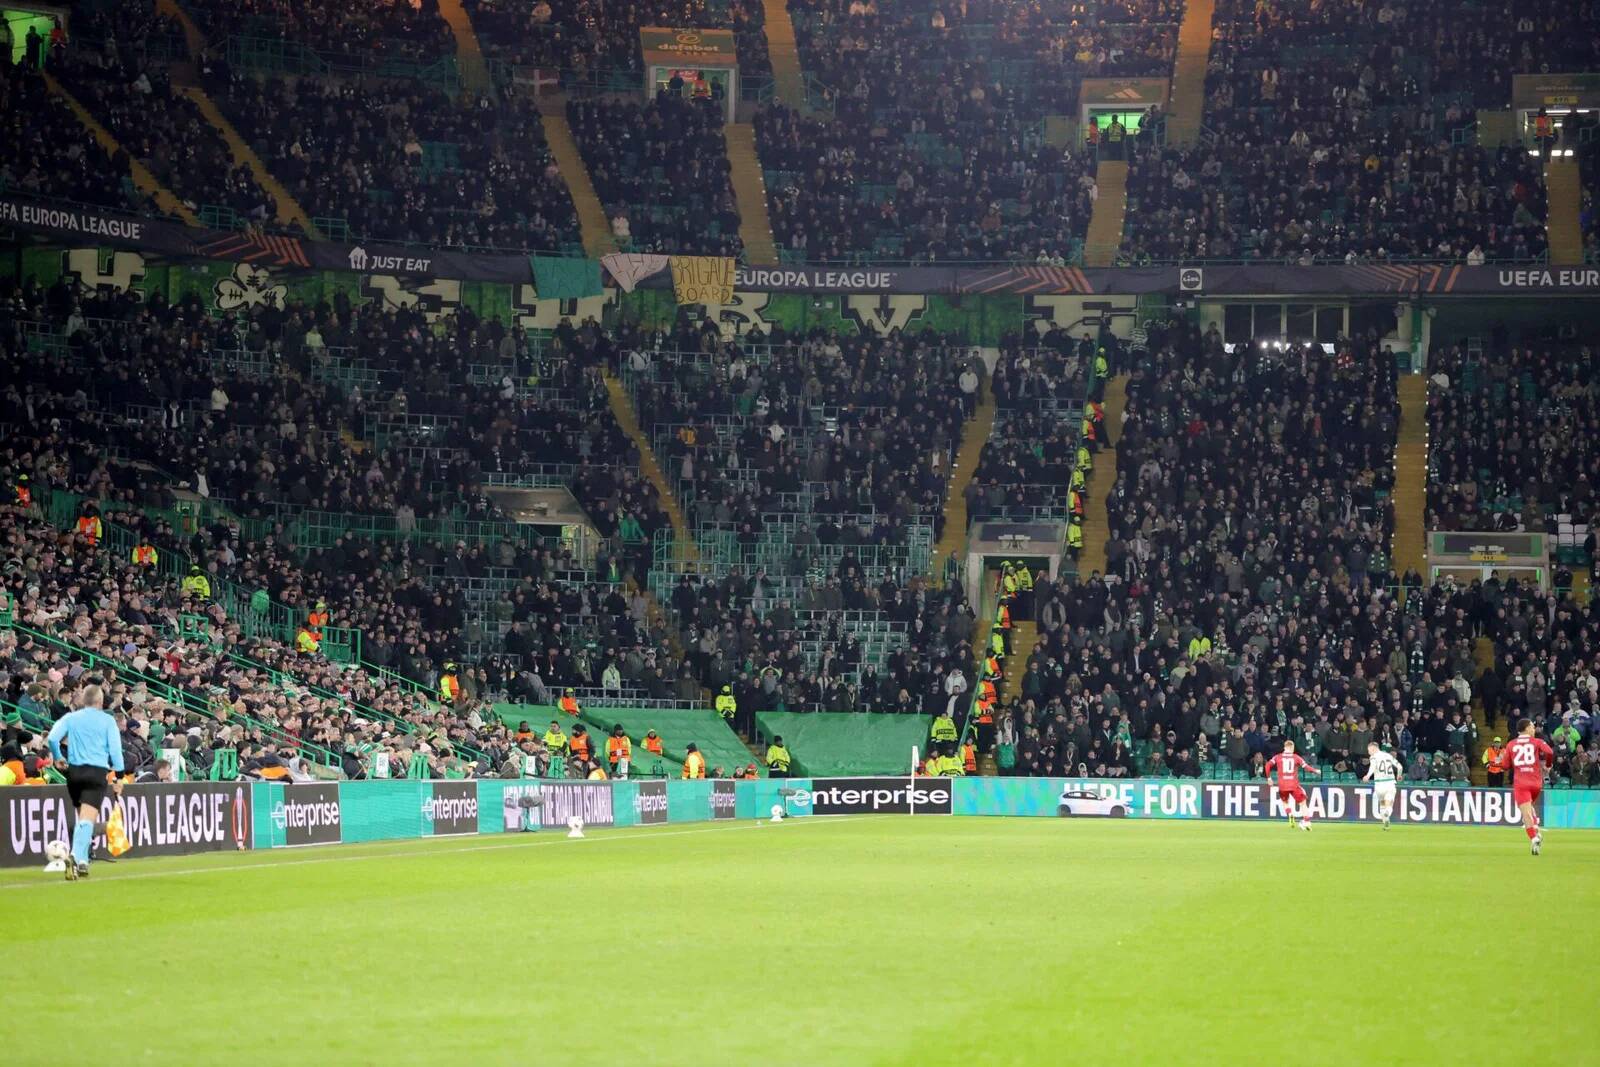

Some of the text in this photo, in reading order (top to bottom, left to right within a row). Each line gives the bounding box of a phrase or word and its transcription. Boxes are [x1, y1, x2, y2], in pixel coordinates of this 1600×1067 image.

[0, 203, 140, 239] FA EUROPA LEAGUE
[371, 255, 431, 272] JUST EAT
[671, 256, 735, 287] BRIGADE
[734, 270, 890, 287] EUROPA LEAGUE
[1499, 270, 1599, 286] UEFA EUR
[675, 287, 730, 304] BOARD
[1282, 756, 1295, 773] 10
[1379, 759, 1392, 775] 42
[1512, 744, 1535, 766] 28
[422, 791, 477, 827] enterprise
[633, 788, 667, 817] enterprise
[786, 785, 949, 809] enterprise
[1063, 783, 1134, 816] RE
[1144, 784, 1198, 816] FOR
[1206, 784, 1265, 817] THE
[1400, 788, 1540, 824] ISTANBU
[10, 792, 225, 855] UEFA ROPA LEAGUE
[270, 794, 339, 836] enterprise
